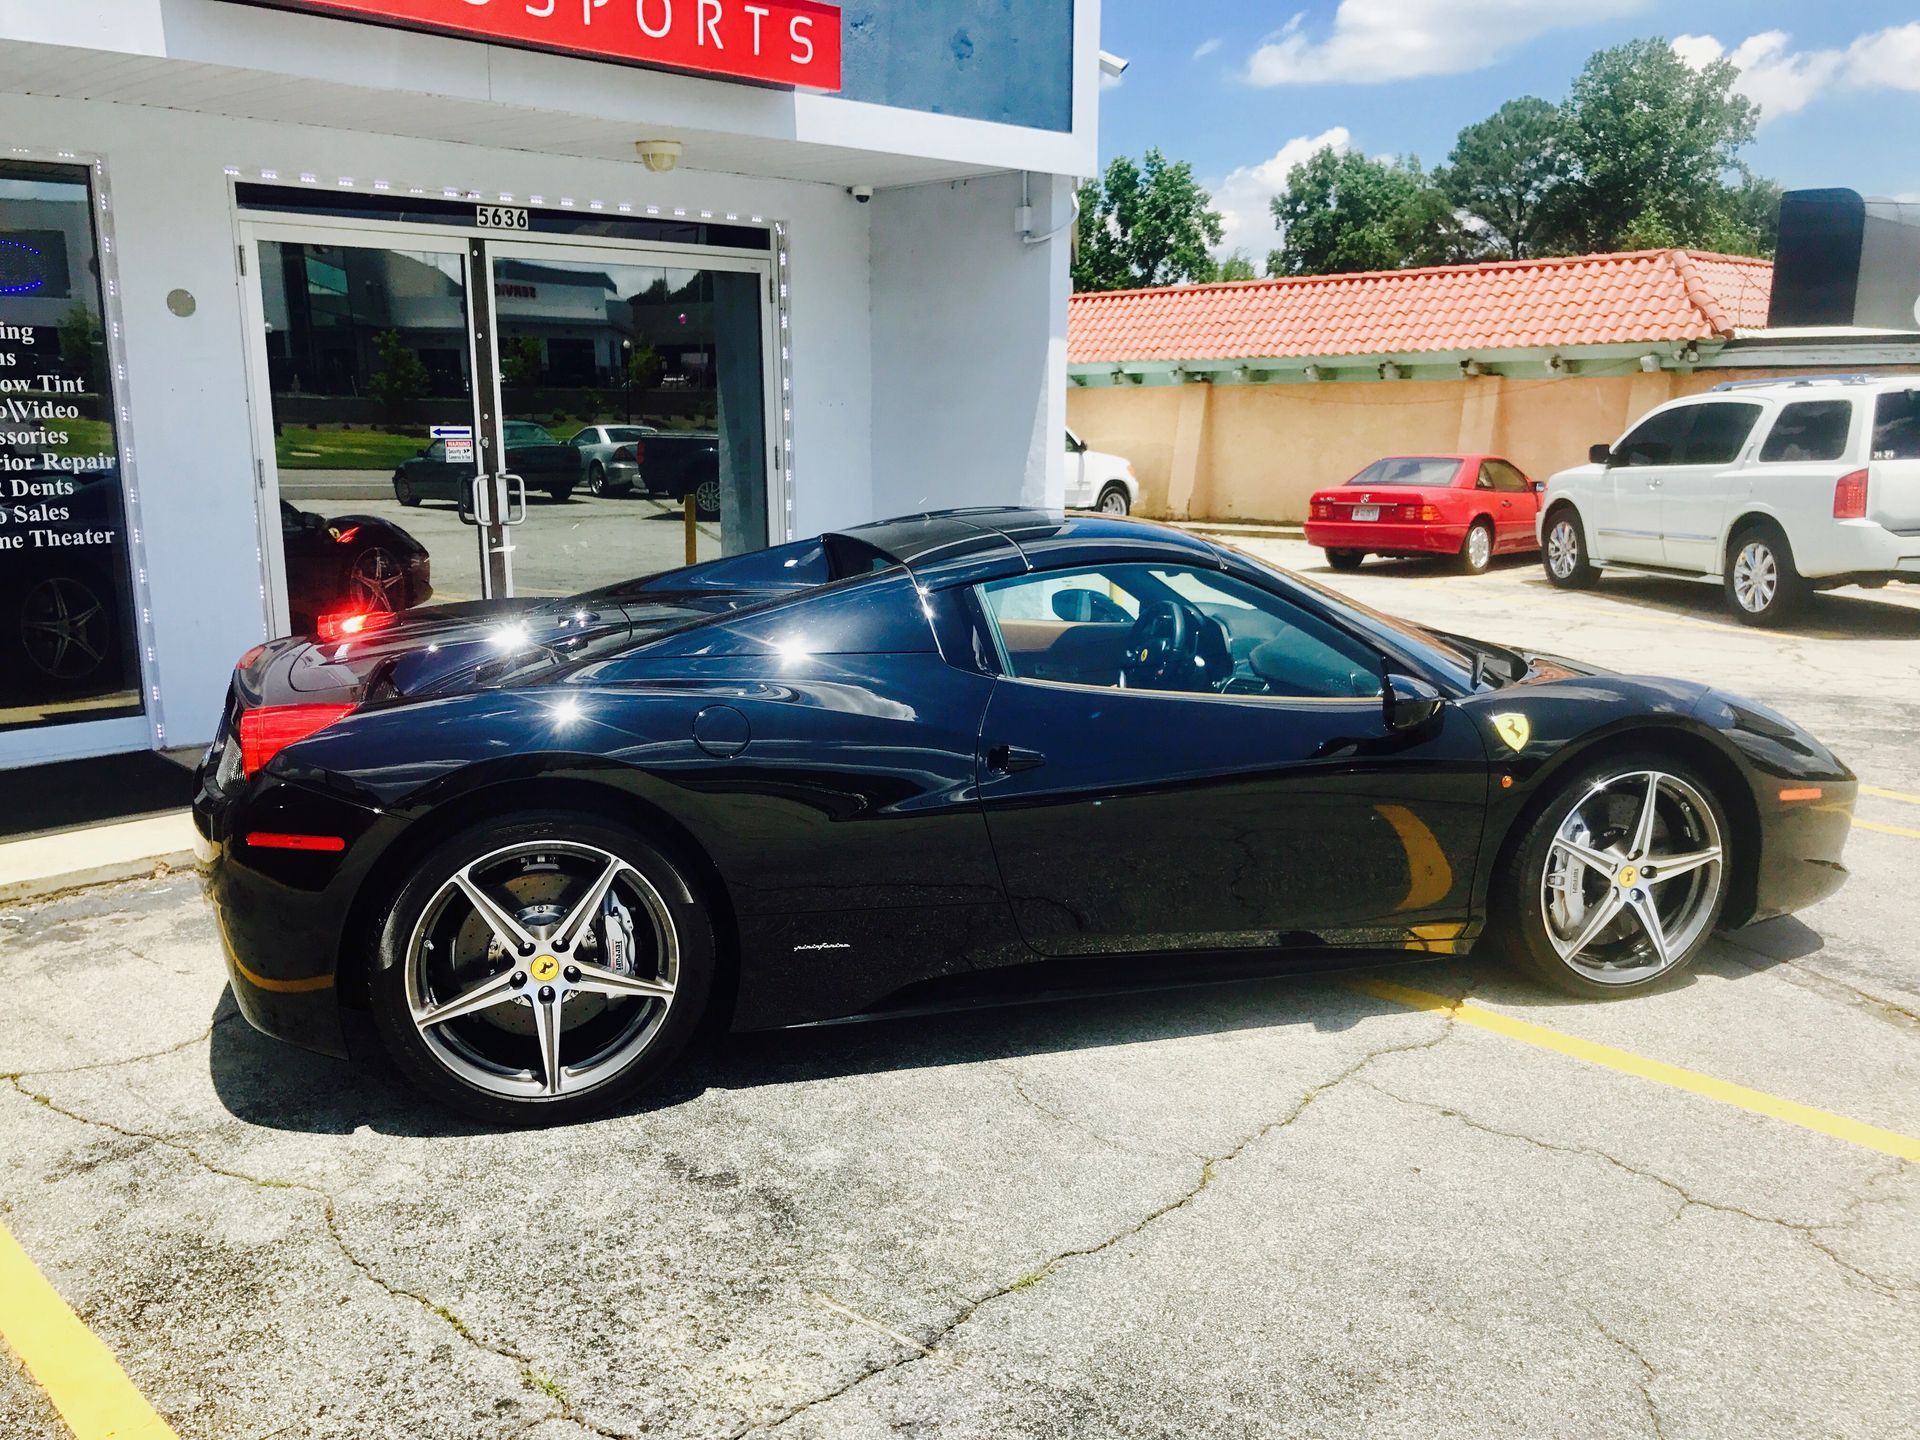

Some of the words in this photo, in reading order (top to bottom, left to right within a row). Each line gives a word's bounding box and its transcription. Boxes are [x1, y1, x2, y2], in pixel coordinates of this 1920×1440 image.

[478, 207, 527, 228] 5636
[36, 374, 85, 393] Tint
[41, 452, 116, 475] Repair
[9, 479, 74, 497] Dents
[13, 503, 70, 524] Sales
[28, 528, 115, 548] Theater
